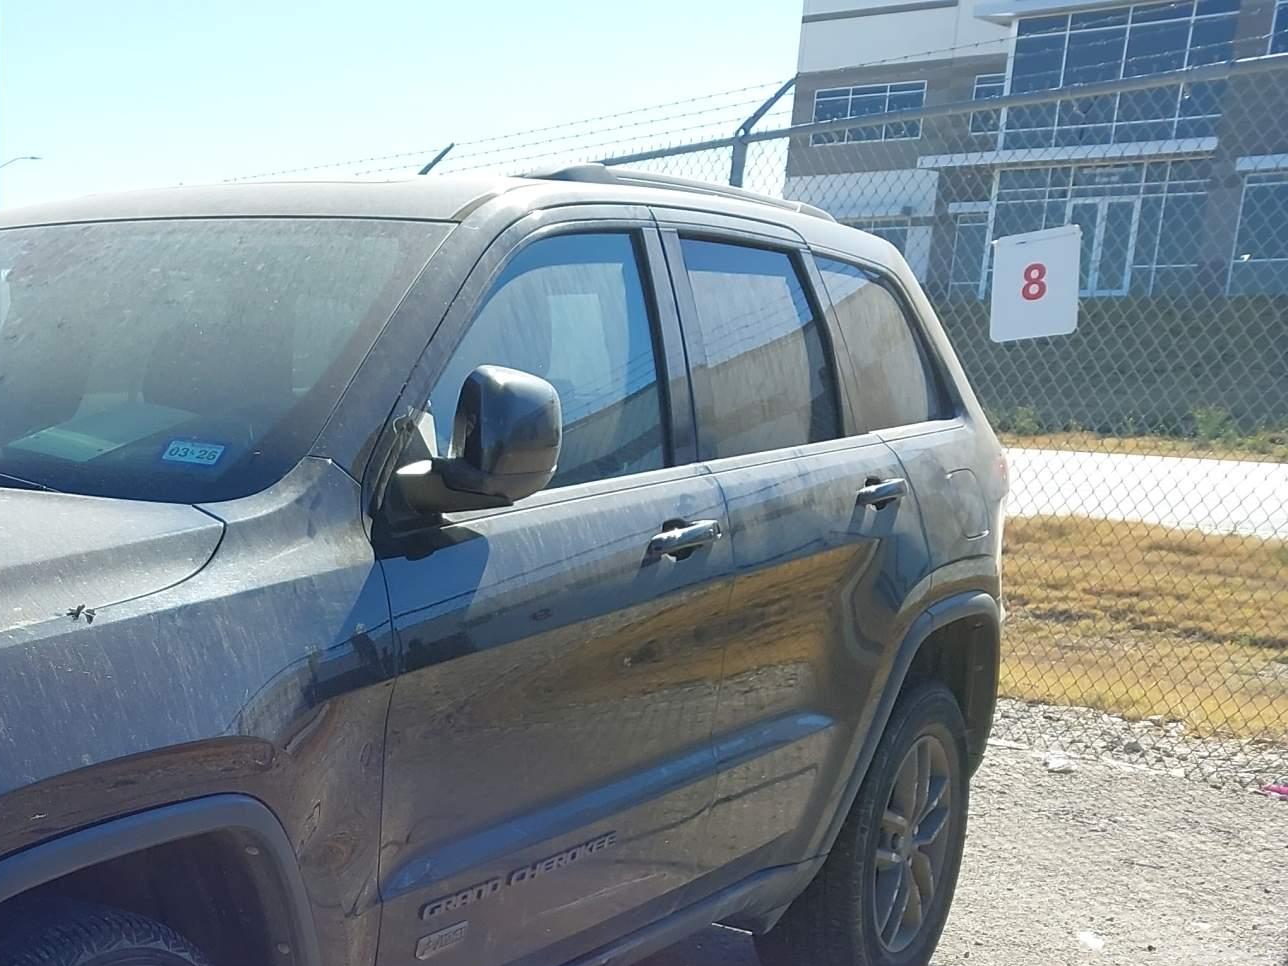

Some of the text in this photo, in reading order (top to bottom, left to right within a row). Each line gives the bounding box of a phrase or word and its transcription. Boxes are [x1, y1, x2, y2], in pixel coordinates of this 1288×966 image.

[1021, 263, 1047, 301] 8
[169, 446, 219, 461] 03 26
[419, 832, 617, 920] GRAND CHEROKEE
